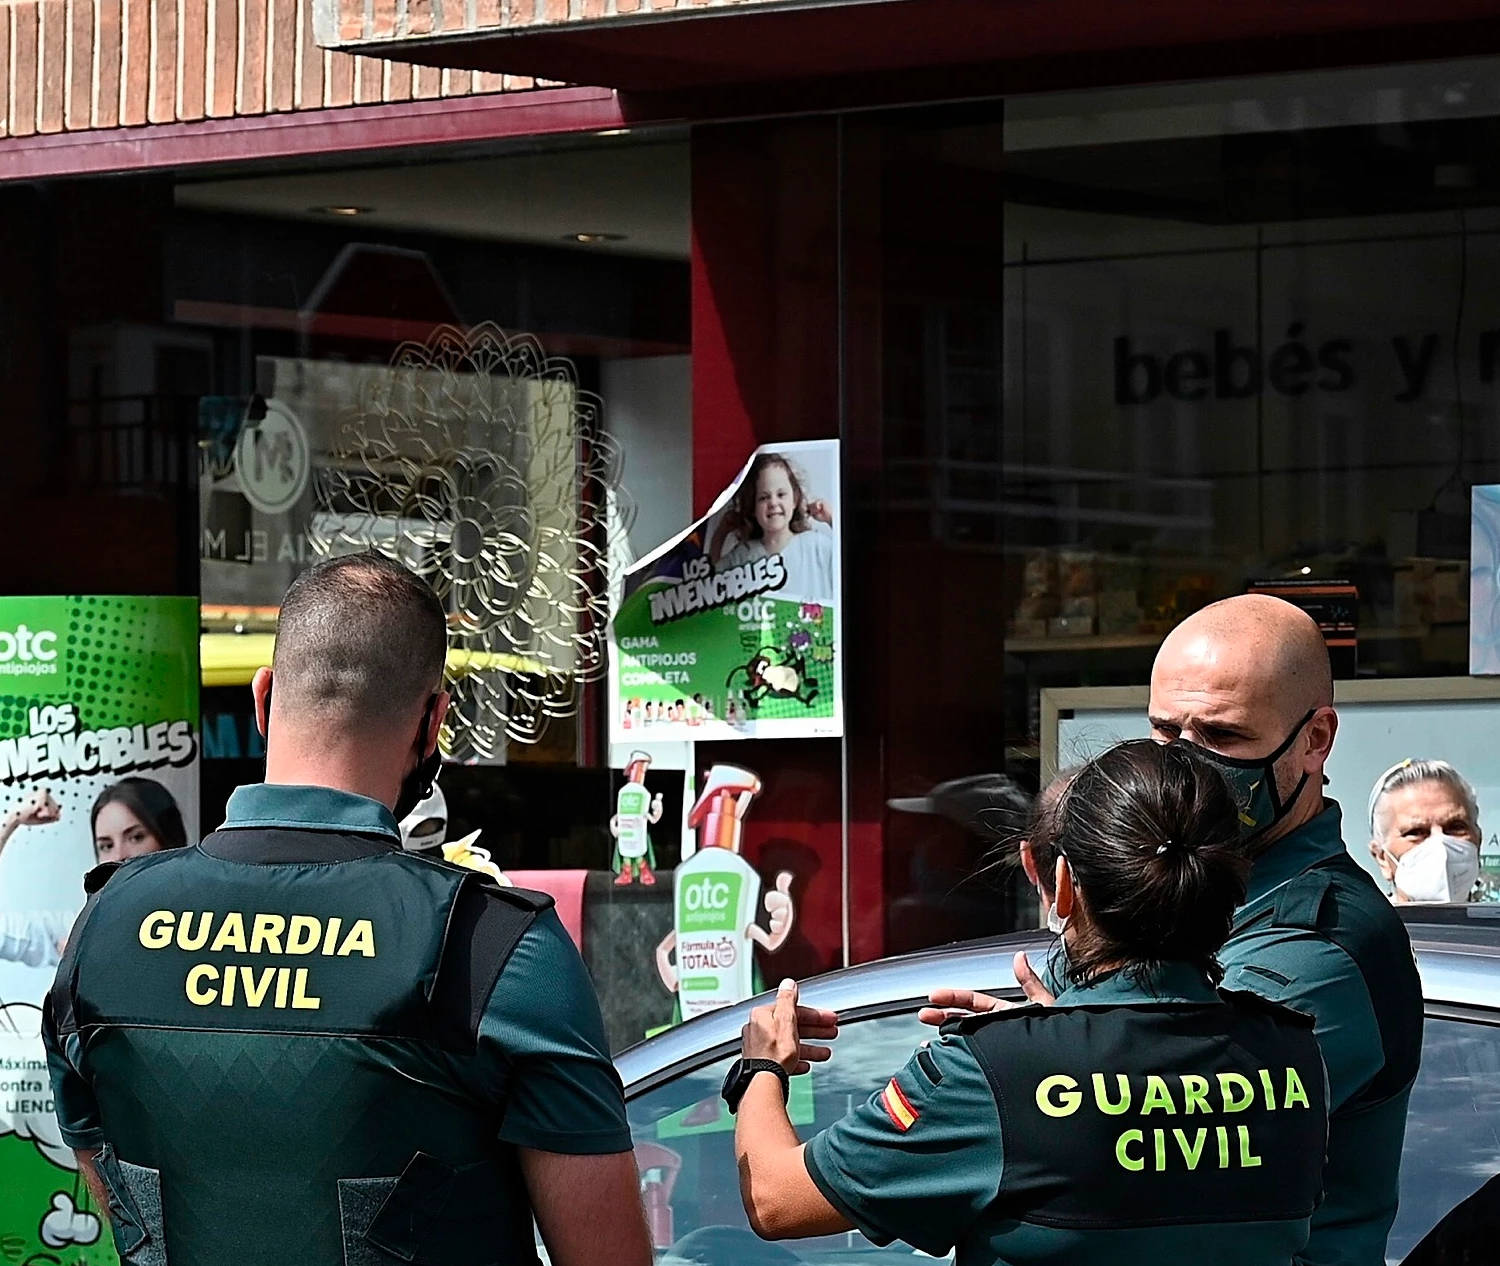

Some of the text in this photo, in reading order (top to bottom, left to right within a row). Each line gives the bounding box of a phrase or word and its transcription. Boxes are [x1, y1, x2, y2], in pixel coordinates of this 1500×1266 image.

[1113, 323, 1354, 405] bebés
[1393, 332, 1440, 403] y
[682, 555, 710, 581] LOS
[737, 596, 777, 622] otc
[621, 637, 660, 650] GAMA
[622, 652, 697, 667] ANTIPIOJOS
[622, 671, 691, 686] COMPLETA
[28, 702, 77, 736] LOS
[684, 876, 730, 912] otc
[137, 910, 377, 958] GUARDIA
[682, 955, 719, 970] TOTAL
[185, 963, 321, 1010] CIVIL
[1035, 1067, 1311, 1118] GUARDIA
[1115, 1125, 1262, 1172] CIVIL
